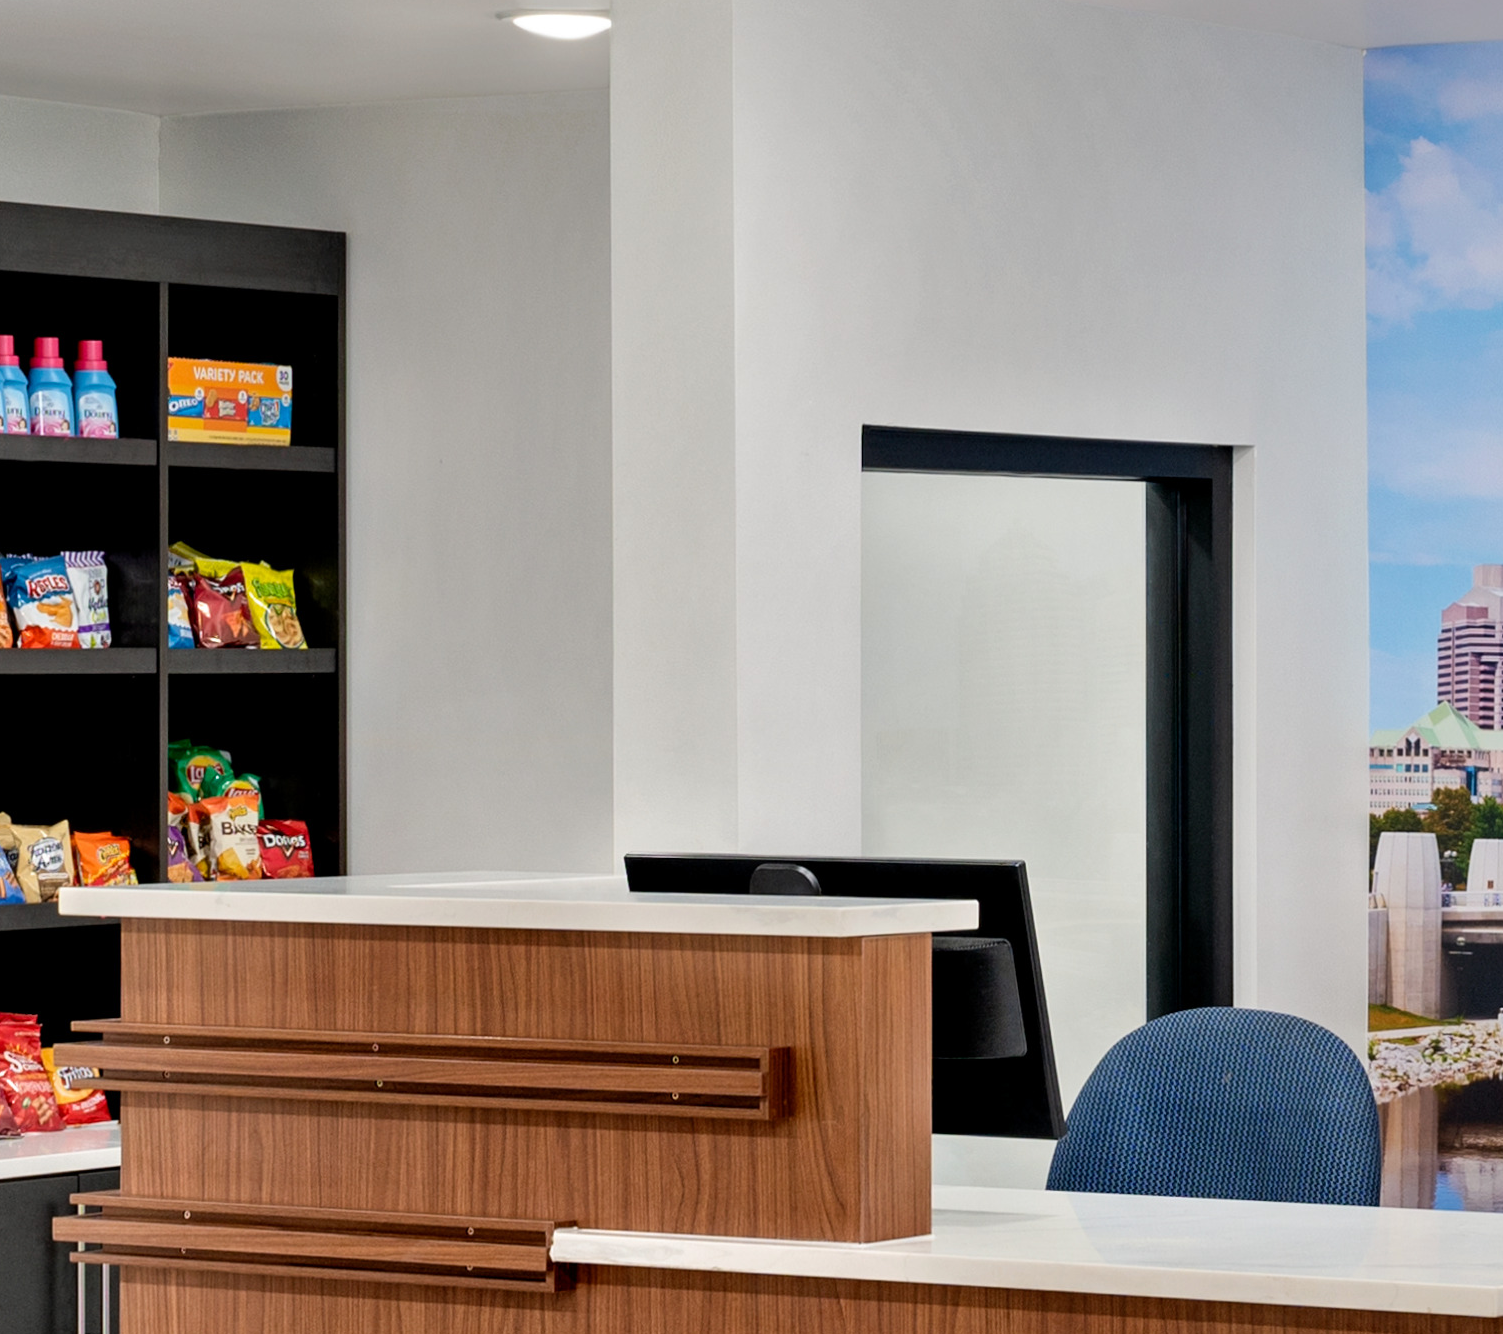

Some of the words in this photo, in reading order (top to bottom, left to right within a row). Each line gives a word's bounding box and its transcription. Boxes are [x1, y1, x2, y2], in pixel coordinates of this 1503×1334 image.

[193, 366, 236, 382] VARIETY
[238, 369, 264, 384] PACK
[168, 397, 198, 412] OREO
[83, 408, 113, 420] Downy
[26, 575, 70, 598] RUFFLES
